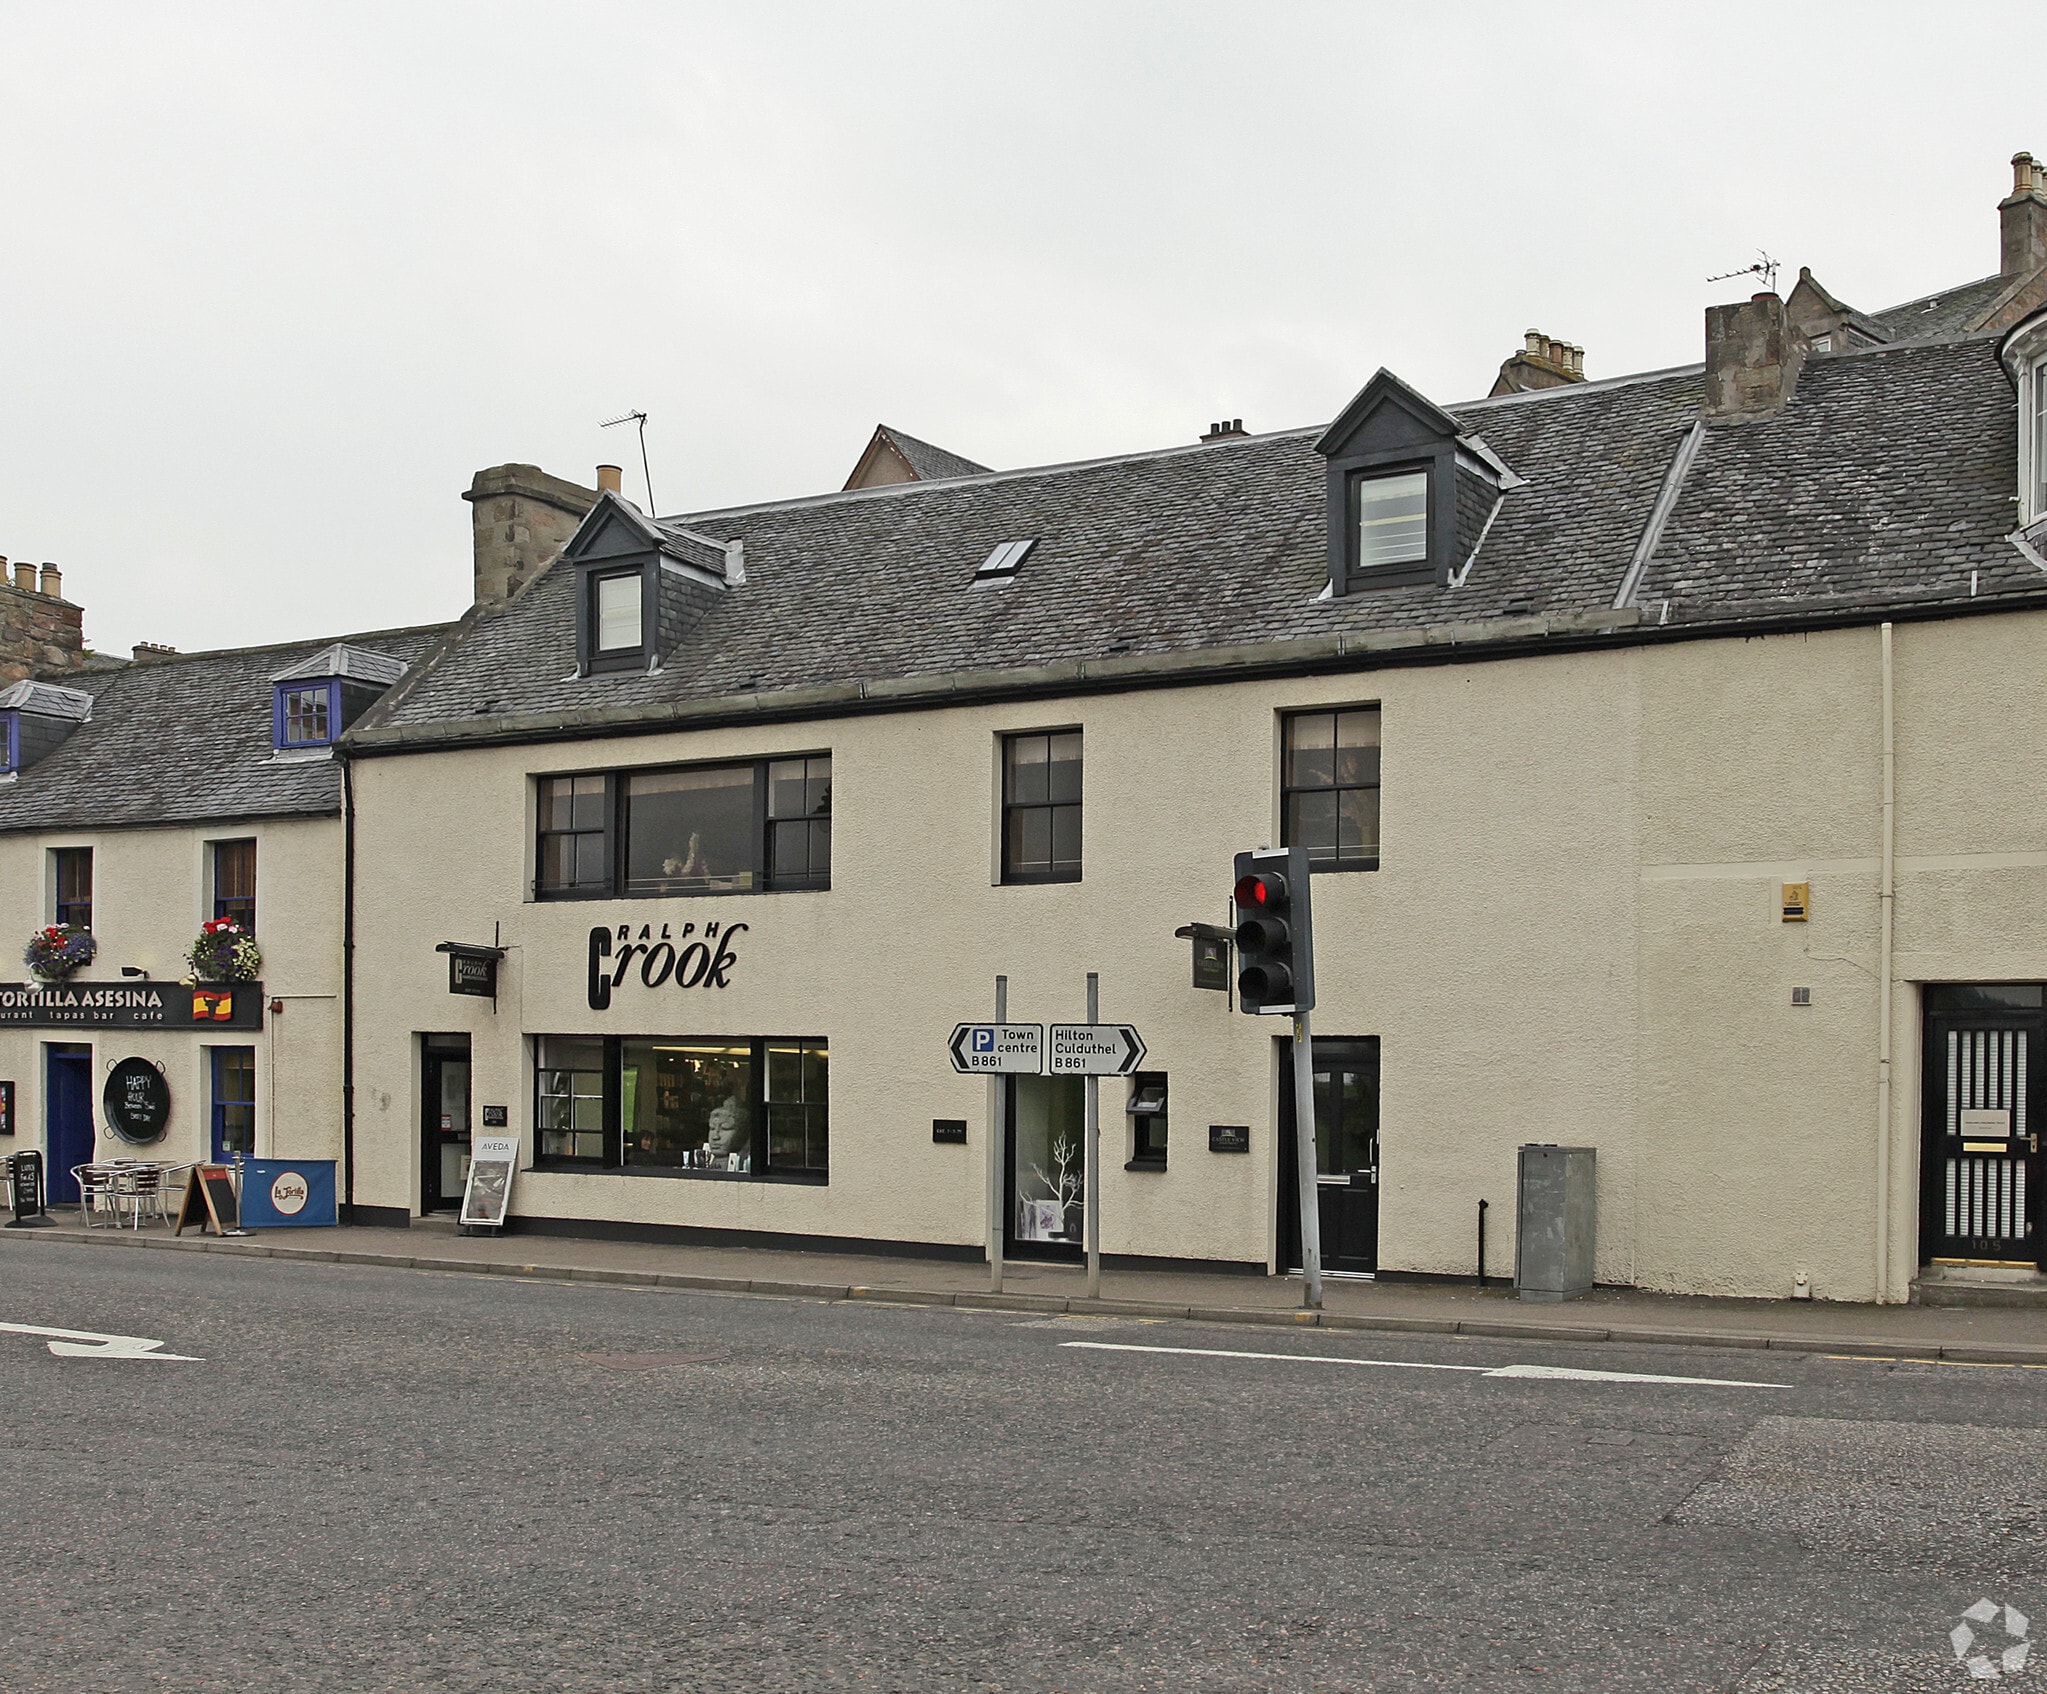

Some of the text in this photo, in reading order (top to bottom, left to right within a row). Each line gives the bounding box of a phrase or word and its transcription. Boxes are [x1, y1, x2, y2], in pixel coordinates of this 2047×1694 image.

[617, 922, 719, 940] RALPH
[455, 959, 491, 984] Crook
[588, 923, 749, 1010] Crook
[81, 990, 163, 1008] ASESINA
[0, 1011, 163, 1020] urant tapas bar cafe
[1001, 1029, 1034, 1040] Town
[1055, 1030, 1093, 1041] Hilton
[997, 1042, 1038, 1053] centre
[1055, 1043, 1117, 1054] Culduthel
[126, 1075, 152, 1090] HAPPY
[481, 1142, 510, 1151] AVEDA
[1972, 1240, 2001, 1251] 105
